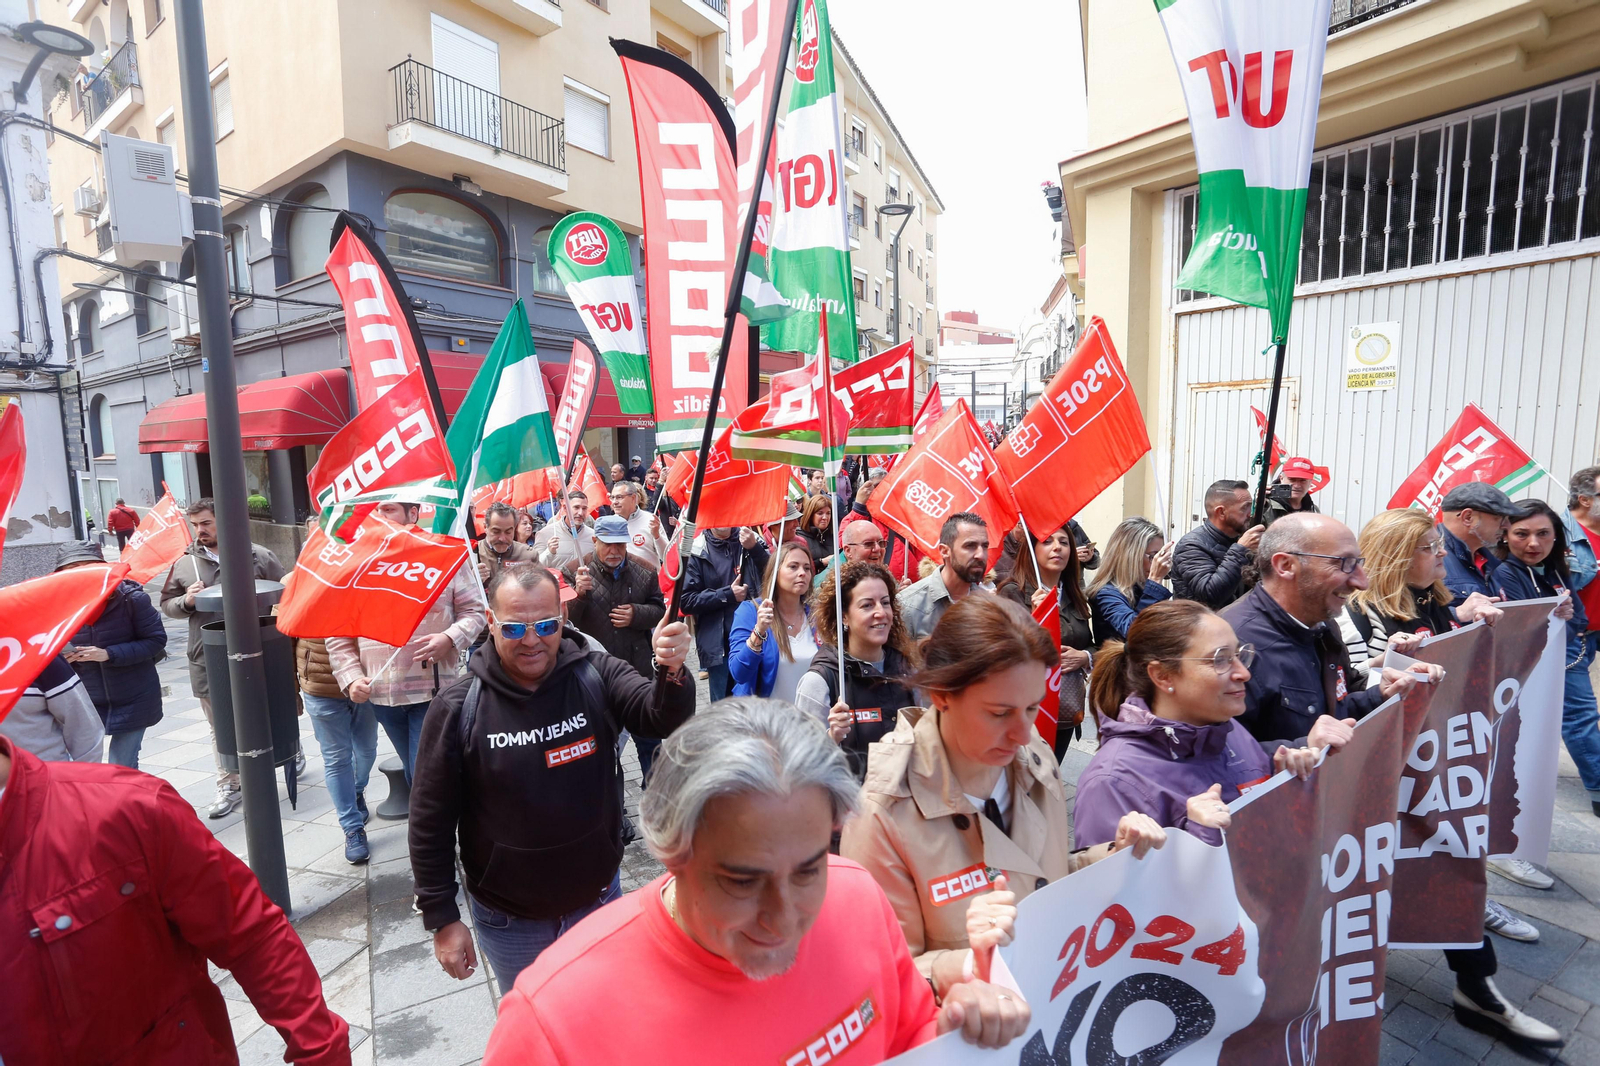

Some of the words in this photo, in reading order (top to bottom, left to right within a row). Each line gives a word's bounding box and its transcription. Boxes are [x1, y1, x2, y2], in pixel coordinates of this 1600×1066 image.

[1347, 380, 1369, 388] LICENCIA
[1369, 371, 1396, 379] ALGECIRAS
[487, 728, 544, 749] TOMMY
[545, 712, 588, 741] JEANS
[549, 741, 592, 765] CCOO
[931, 868, 989, 903] CCOO
[1049, 903, 1247, 1003] 2024
